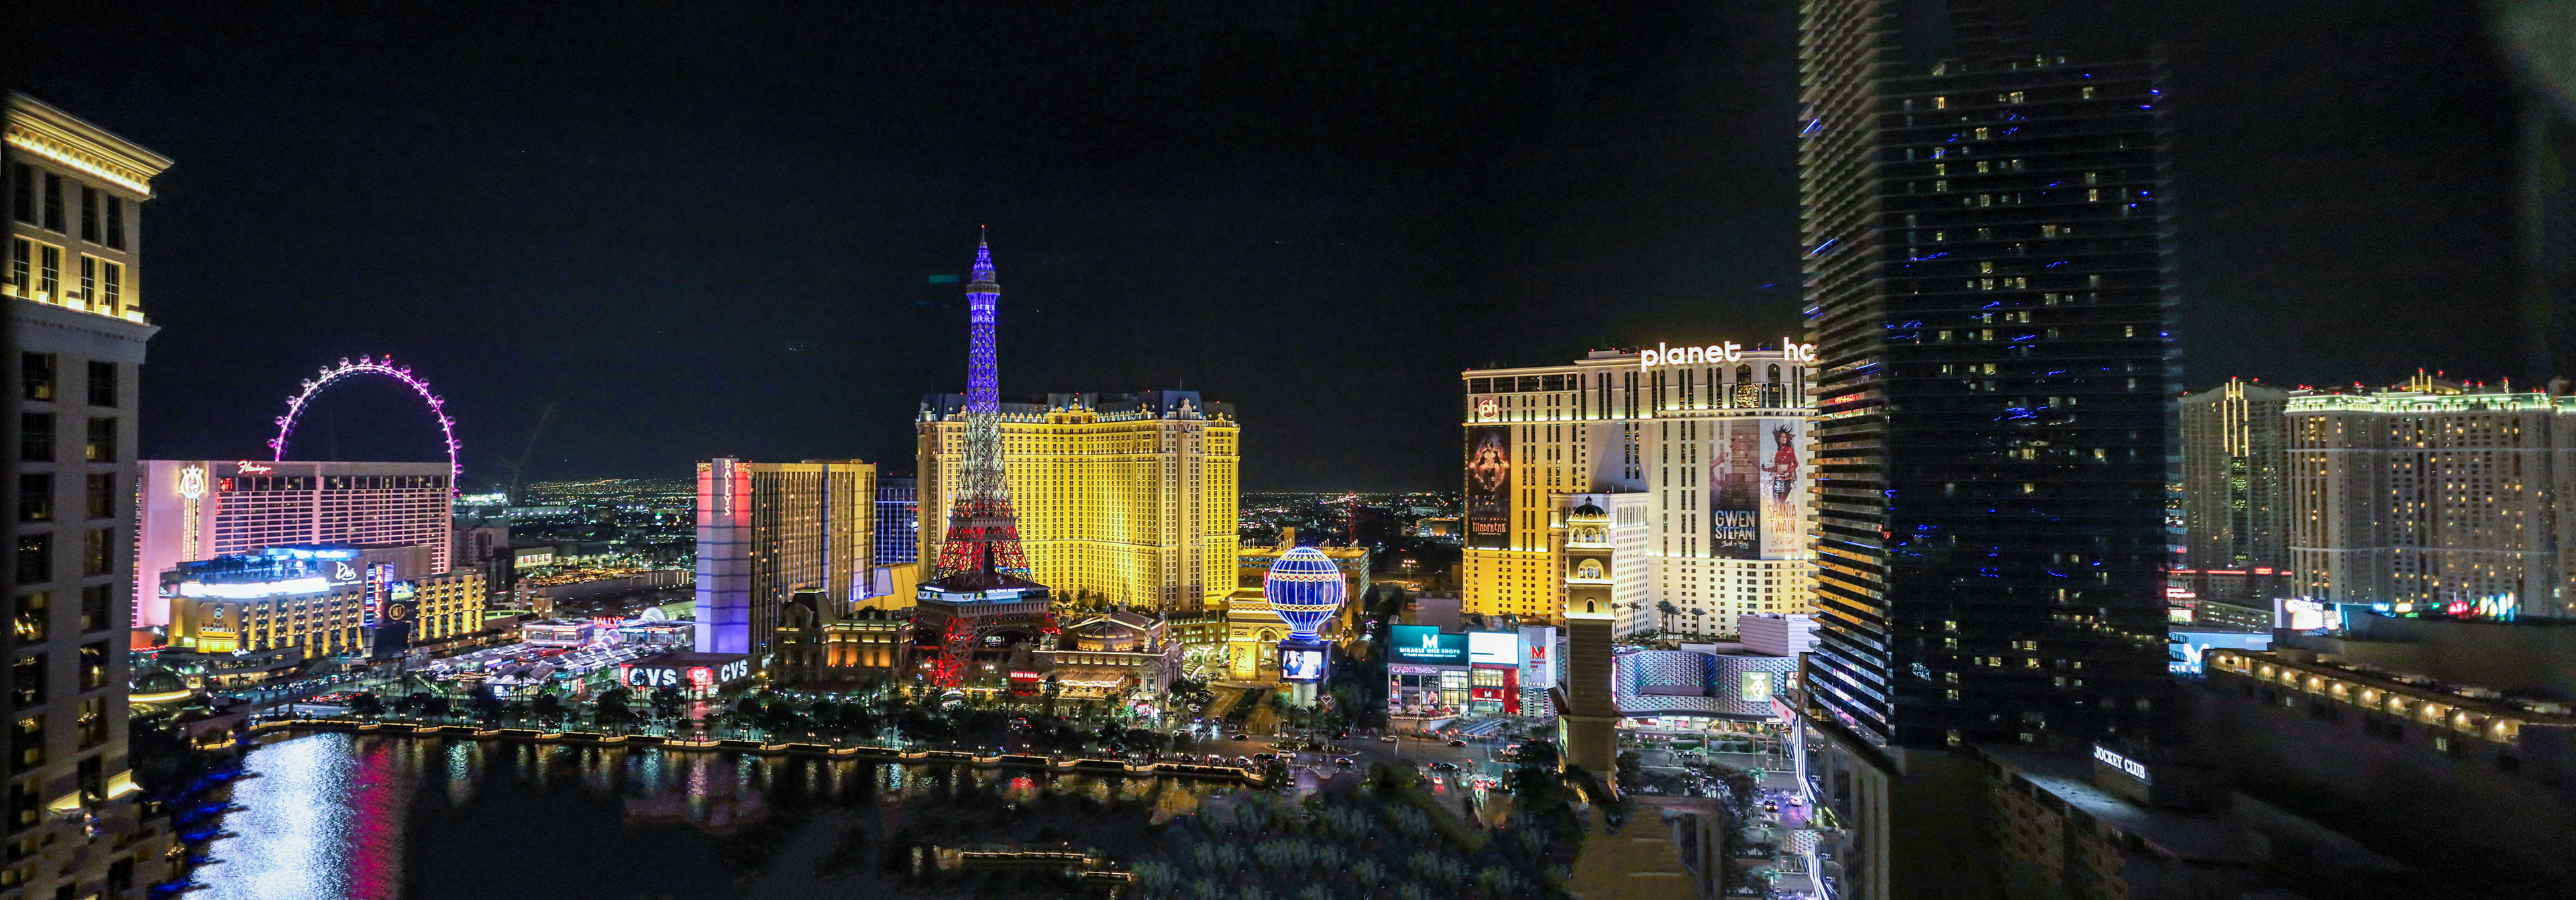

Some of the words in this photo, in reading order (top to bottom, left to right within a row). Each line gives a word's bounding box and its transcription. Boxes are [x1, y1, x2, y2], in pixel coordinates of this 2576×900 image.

[1641, 340, 1741, 373] planet
[237, 459, 272, 475] Flamingo
[1715, 510, 1756, 528] GWEN
[1767, 504, 1797, 519] SHANIA
[1472, 522, 1507, 532] MINDFREAK
[1715, 526, 1756, 541] STEFANI
[1770, 520, 1795, 534] TWAIN
[593, 616, 626, 626] BALLY'S
[1423, 634, 1438, 649] M
[1530, 645, 1546, 660] M
[629, 668, 678, 687] CVS
[720, 659, 749, 683] CVS
[2094, 746, 2123, 769] JOCKEY
[2124, 758, 2146, 779] CLUB
